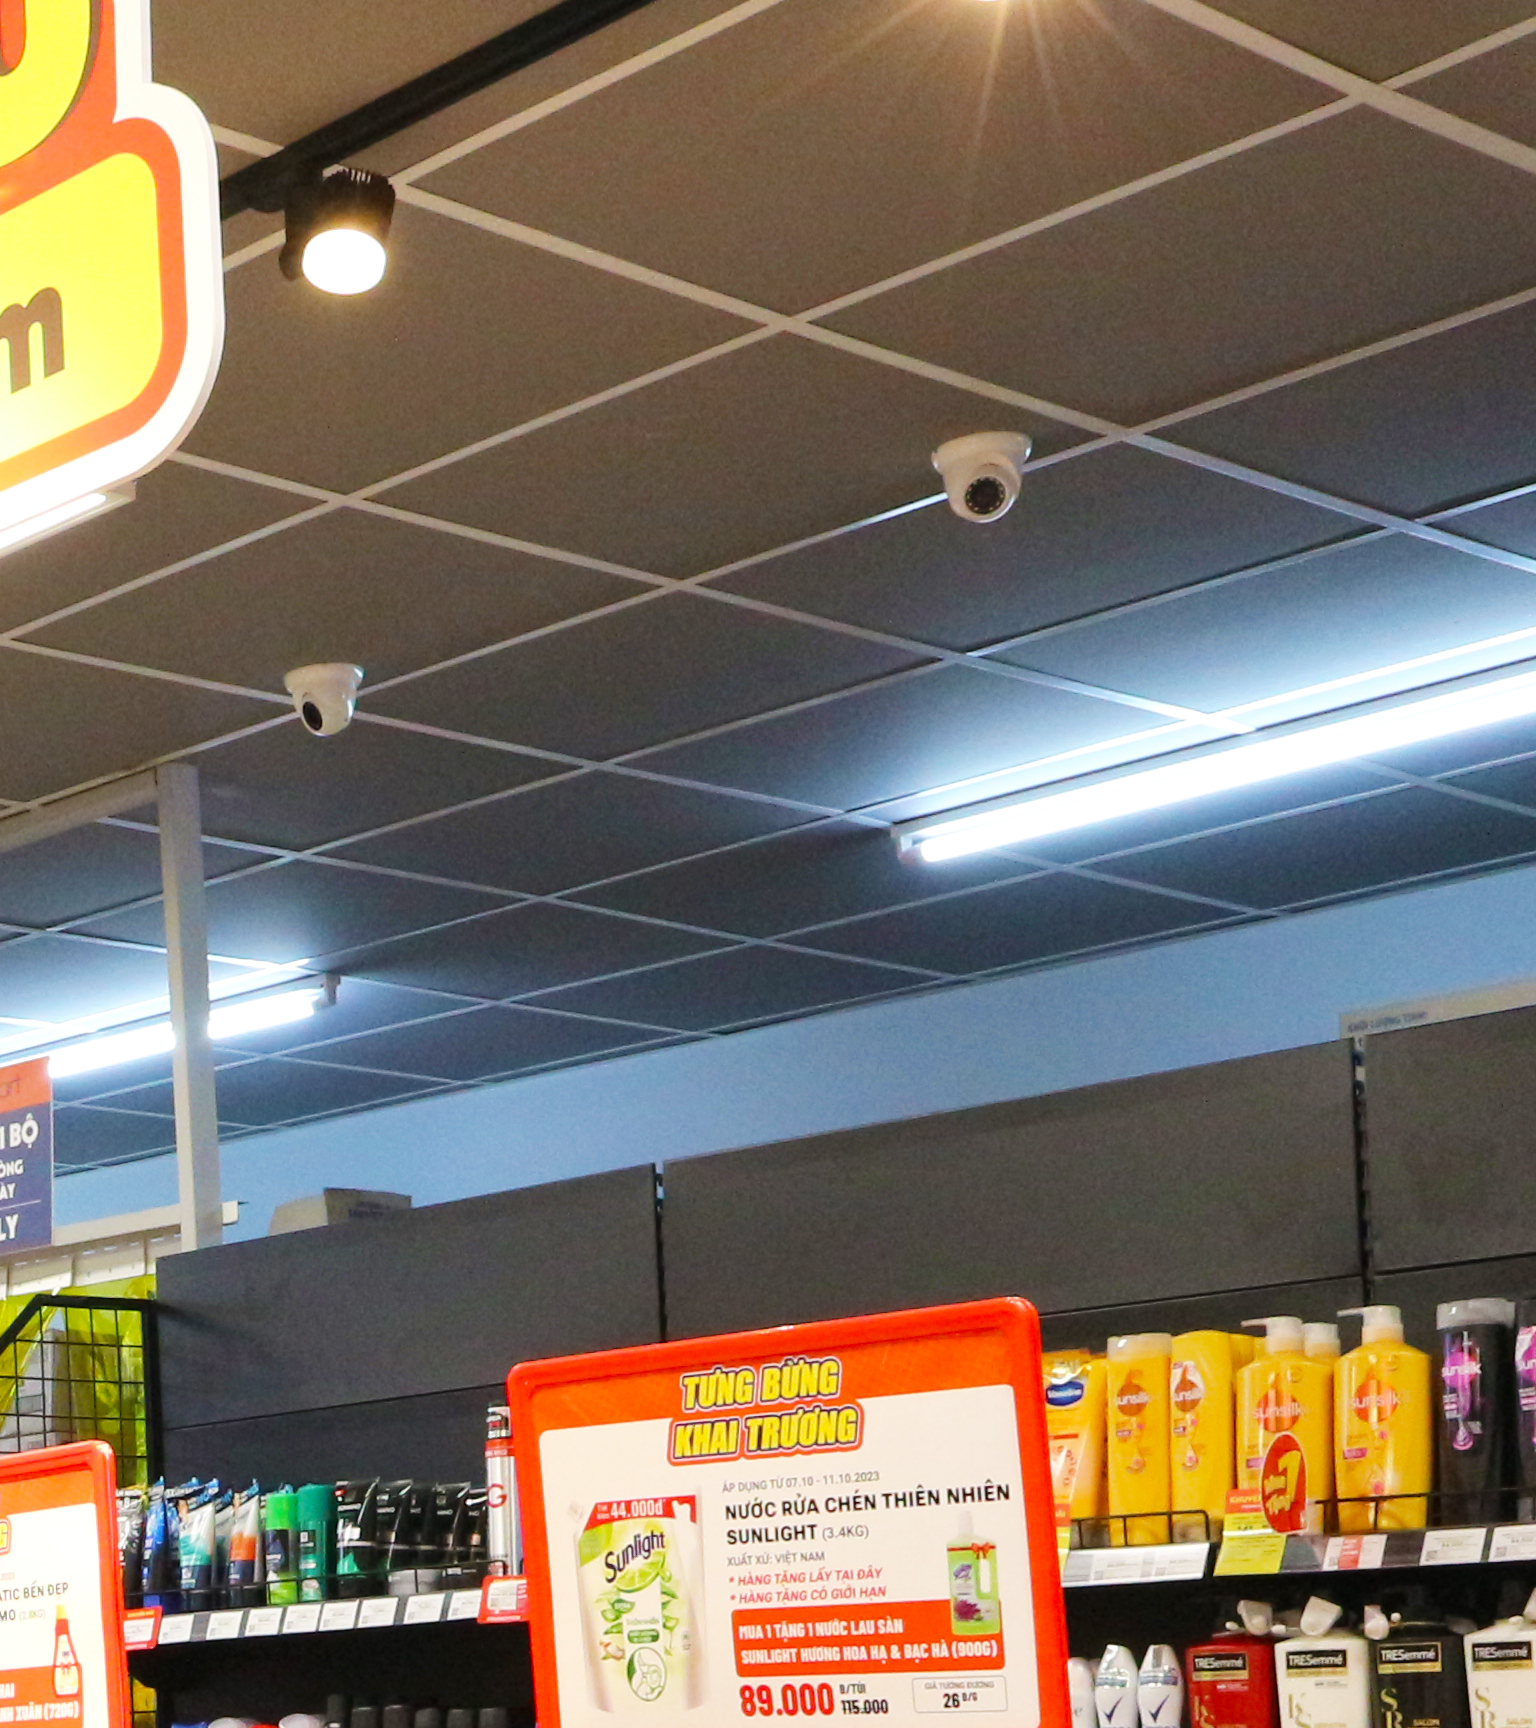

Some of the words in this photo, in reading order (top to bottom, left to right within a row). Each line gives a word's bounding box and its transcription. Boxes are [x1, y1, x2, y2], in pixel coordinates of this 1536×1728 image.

[9, 1113, 38, 1148] BỘ
[760, 1358, 840, 1402] BỪNG
[674, 1418, 740, 1460] KHAI
[745, 1406, 858, 1452] TRƯƠNG
[722, 1480, 735, 1493] ÁP
[738, 1480, 767, 1492] DỤNG
[770, 1478, 784, 1489] TỪ
[786, 1476, 813, 1488] 07.10
[823, 1470, 880, 1486] 11.10.2023
[726, 1500, 777, 1520] NƯỚC
[782, 1492, 819, 1516] RỬA
[825, 1490, 877, 1513] CHÉN
[882, 1484, 940, 1509] THIÊN
[947, 1479, 1011, 1505] NHIÊN
[727, 1524, 818, 1545] SUNLIGHT
[822, 1525, 869, 1542] (3.4KG)
[605, 1530, 665, 1583] Sunlight
[727, 1553, 754, 1567] XUẤT
[756, 1552, 772, 1565] XỨ:
[776, 1550, 797, 1564] VIỆT
[800, 1552, 825, 1562] NAM
[738, 1571, 770, 1586] HÀNG
[774, 1571, 806, 1589] TẶNG
[810, 1568, 832, 1583] LẤY
[836, 1570, 854, 1583] TẠI
[857, 1568, 882, 1580] ĐÂY
[739, 1587, 772, 1604] HÀNG
[776, 1587, 808, 1605] TẶNG
[811, 1584, 829, 1600] CÓ
[832, 1586, 856, 1598] GIỚI
[860, 1586, 886, 1600] HẠN
[739, 1625, 764, 1640] MUA
[773, 1622, 805, 1642] TẶNG
[816, 1619, 848, 1636] NƯỚC
[850, 1620, 875, 1635] LAU
[878, 1615, 904, 1634] SÀN
[741, 1648, 797, 1664] SUNLIGHT
[801, 1644, 840, 1662] HƯƠNG
[843, 1646, 866, 1660] HOA
[870, 1645, 887, 1664] HẠ
[890, 1645, 901, 1659] &
[904, 1643, 929, 1663] BẠC
[932, 1638, 949, 1658] HÀ
[951, 1640, 998, 1658] (900G)
[739, 1683, 835, 1717] 89.000
[943, 1693, 961, 1709] 26
